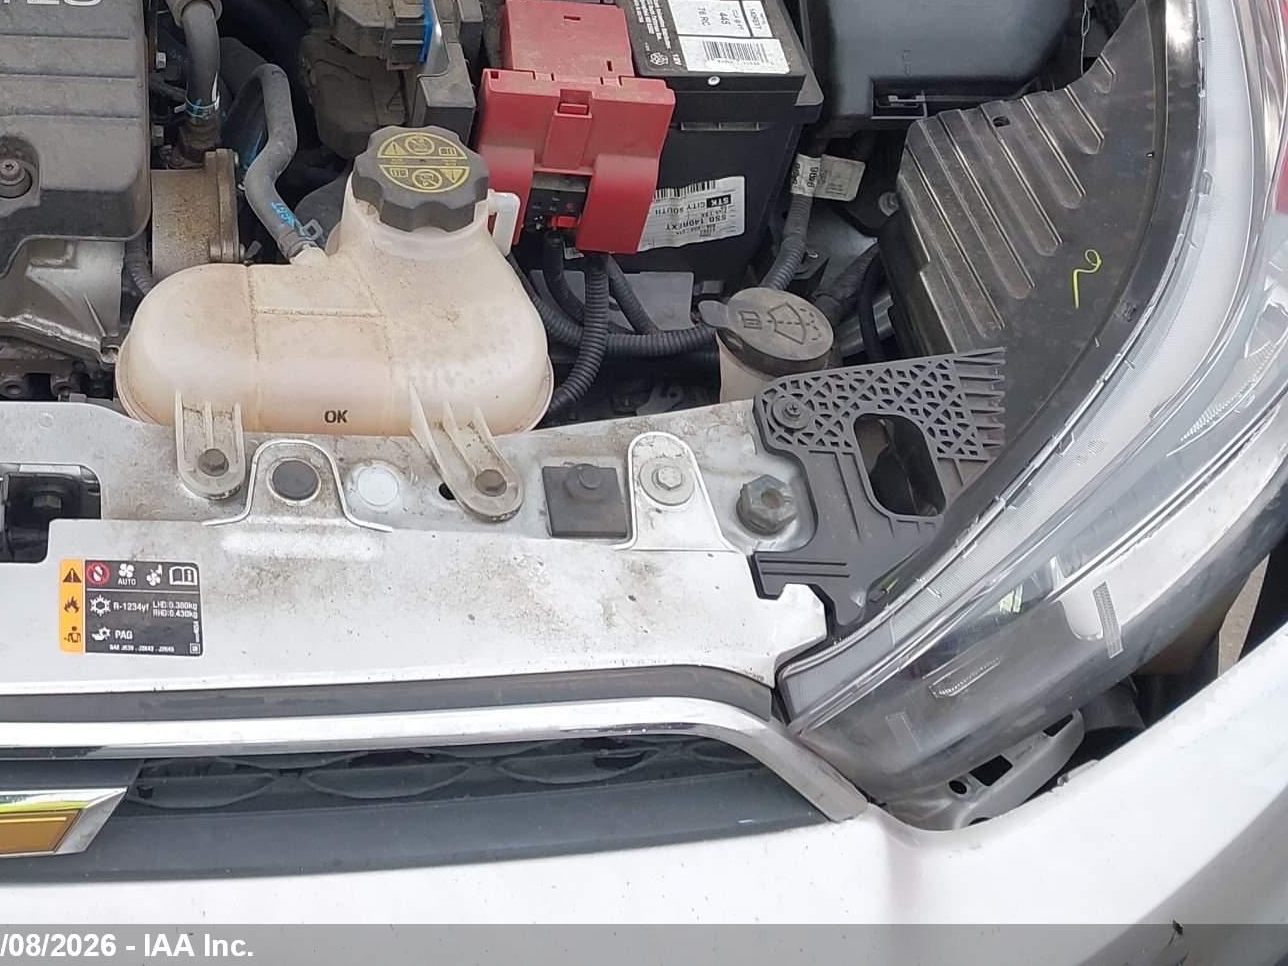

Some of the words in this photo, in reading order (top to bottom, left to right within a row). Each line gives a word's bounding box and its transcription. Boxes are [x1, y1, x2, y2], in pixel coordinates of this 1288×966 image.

[655, 206, 684, 215] SOUTH
[686, 201, 706, 211] CITY
[324, 409, 348, 423] OK
[117, 577, 137, 586] AUTO
[114, 629, 134, 640] PAG
